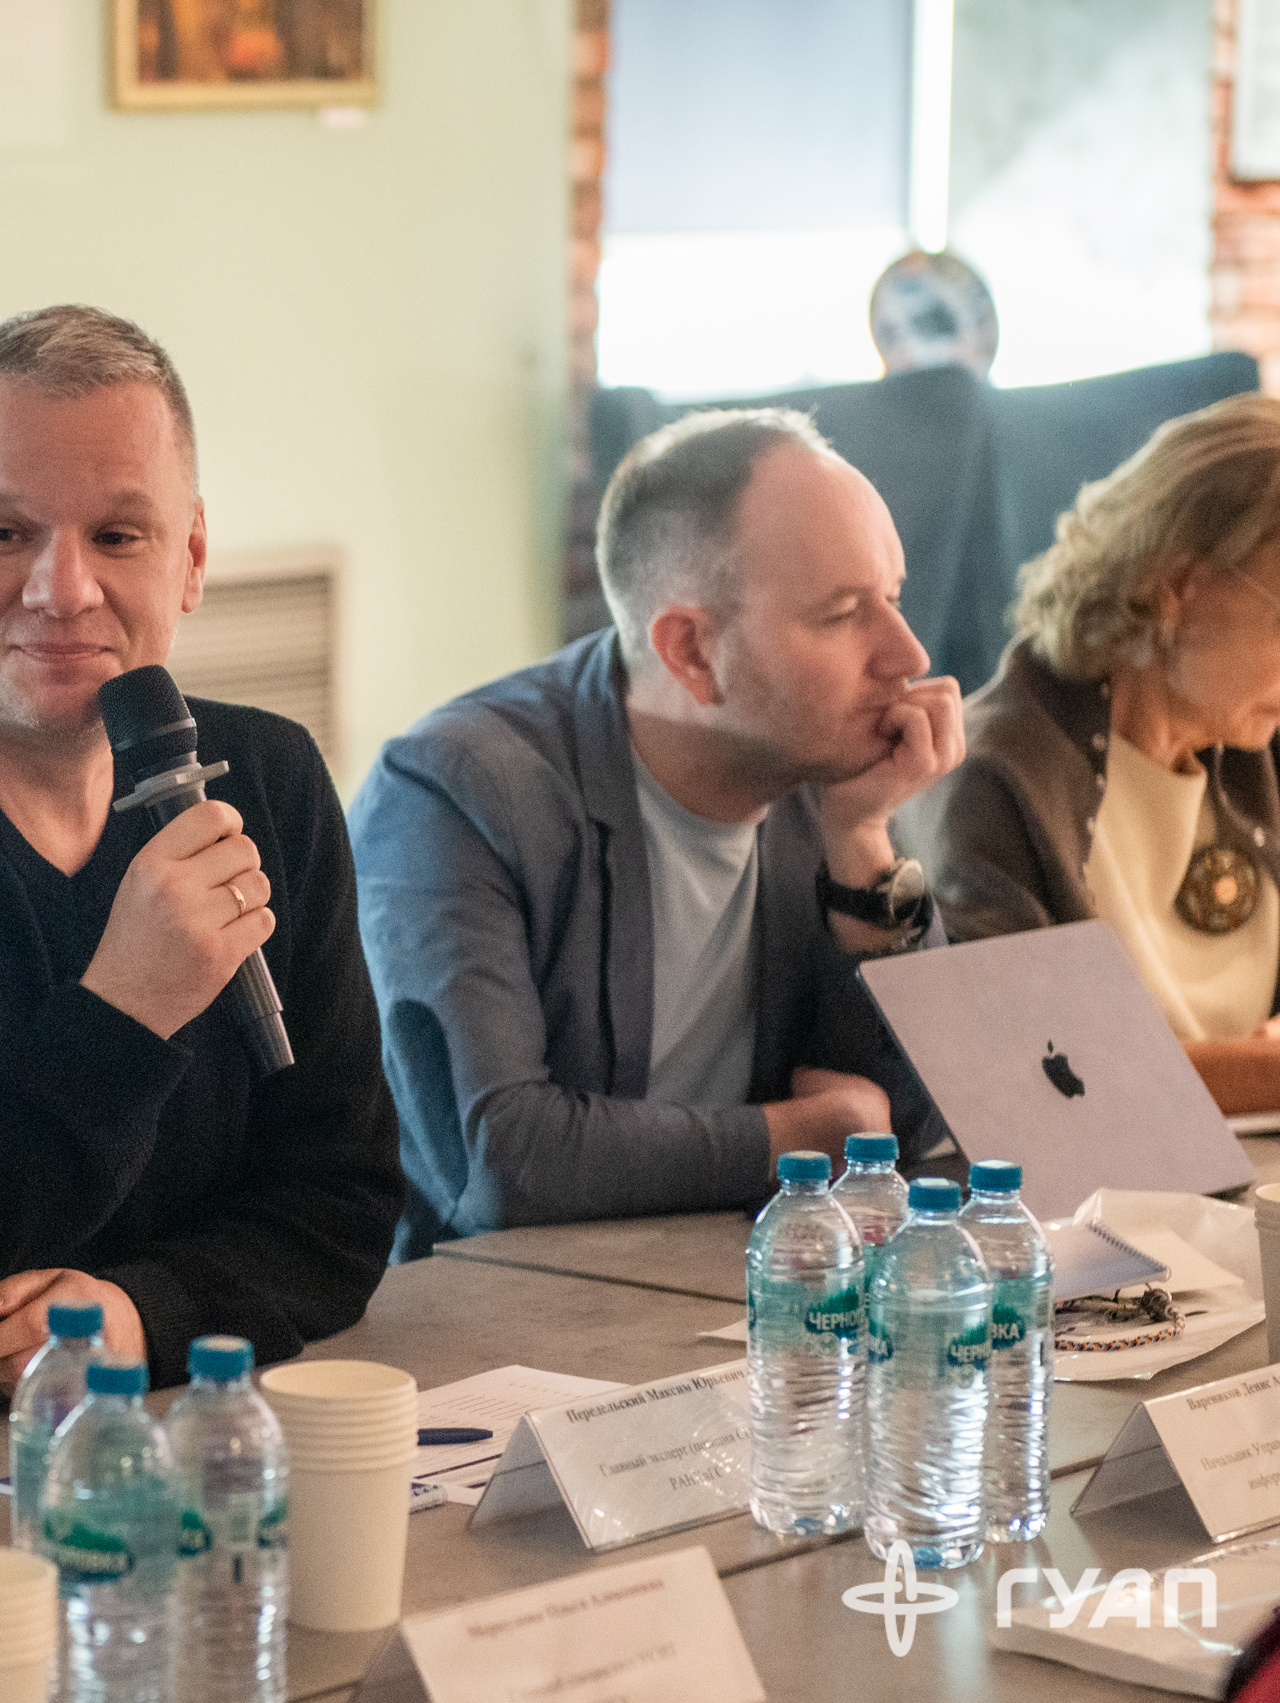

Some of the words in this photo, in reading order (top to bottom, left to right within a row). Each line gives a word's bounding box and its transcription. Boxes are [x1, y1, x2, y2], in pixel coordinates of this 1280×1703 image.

[566, 1393, 646, 1423] Передельский
[646, 1383, 692, 1402] Максим
[692, 1369, 745, 1390] Юрьевич
[1241, 1379, 1271, 1397] Денис
